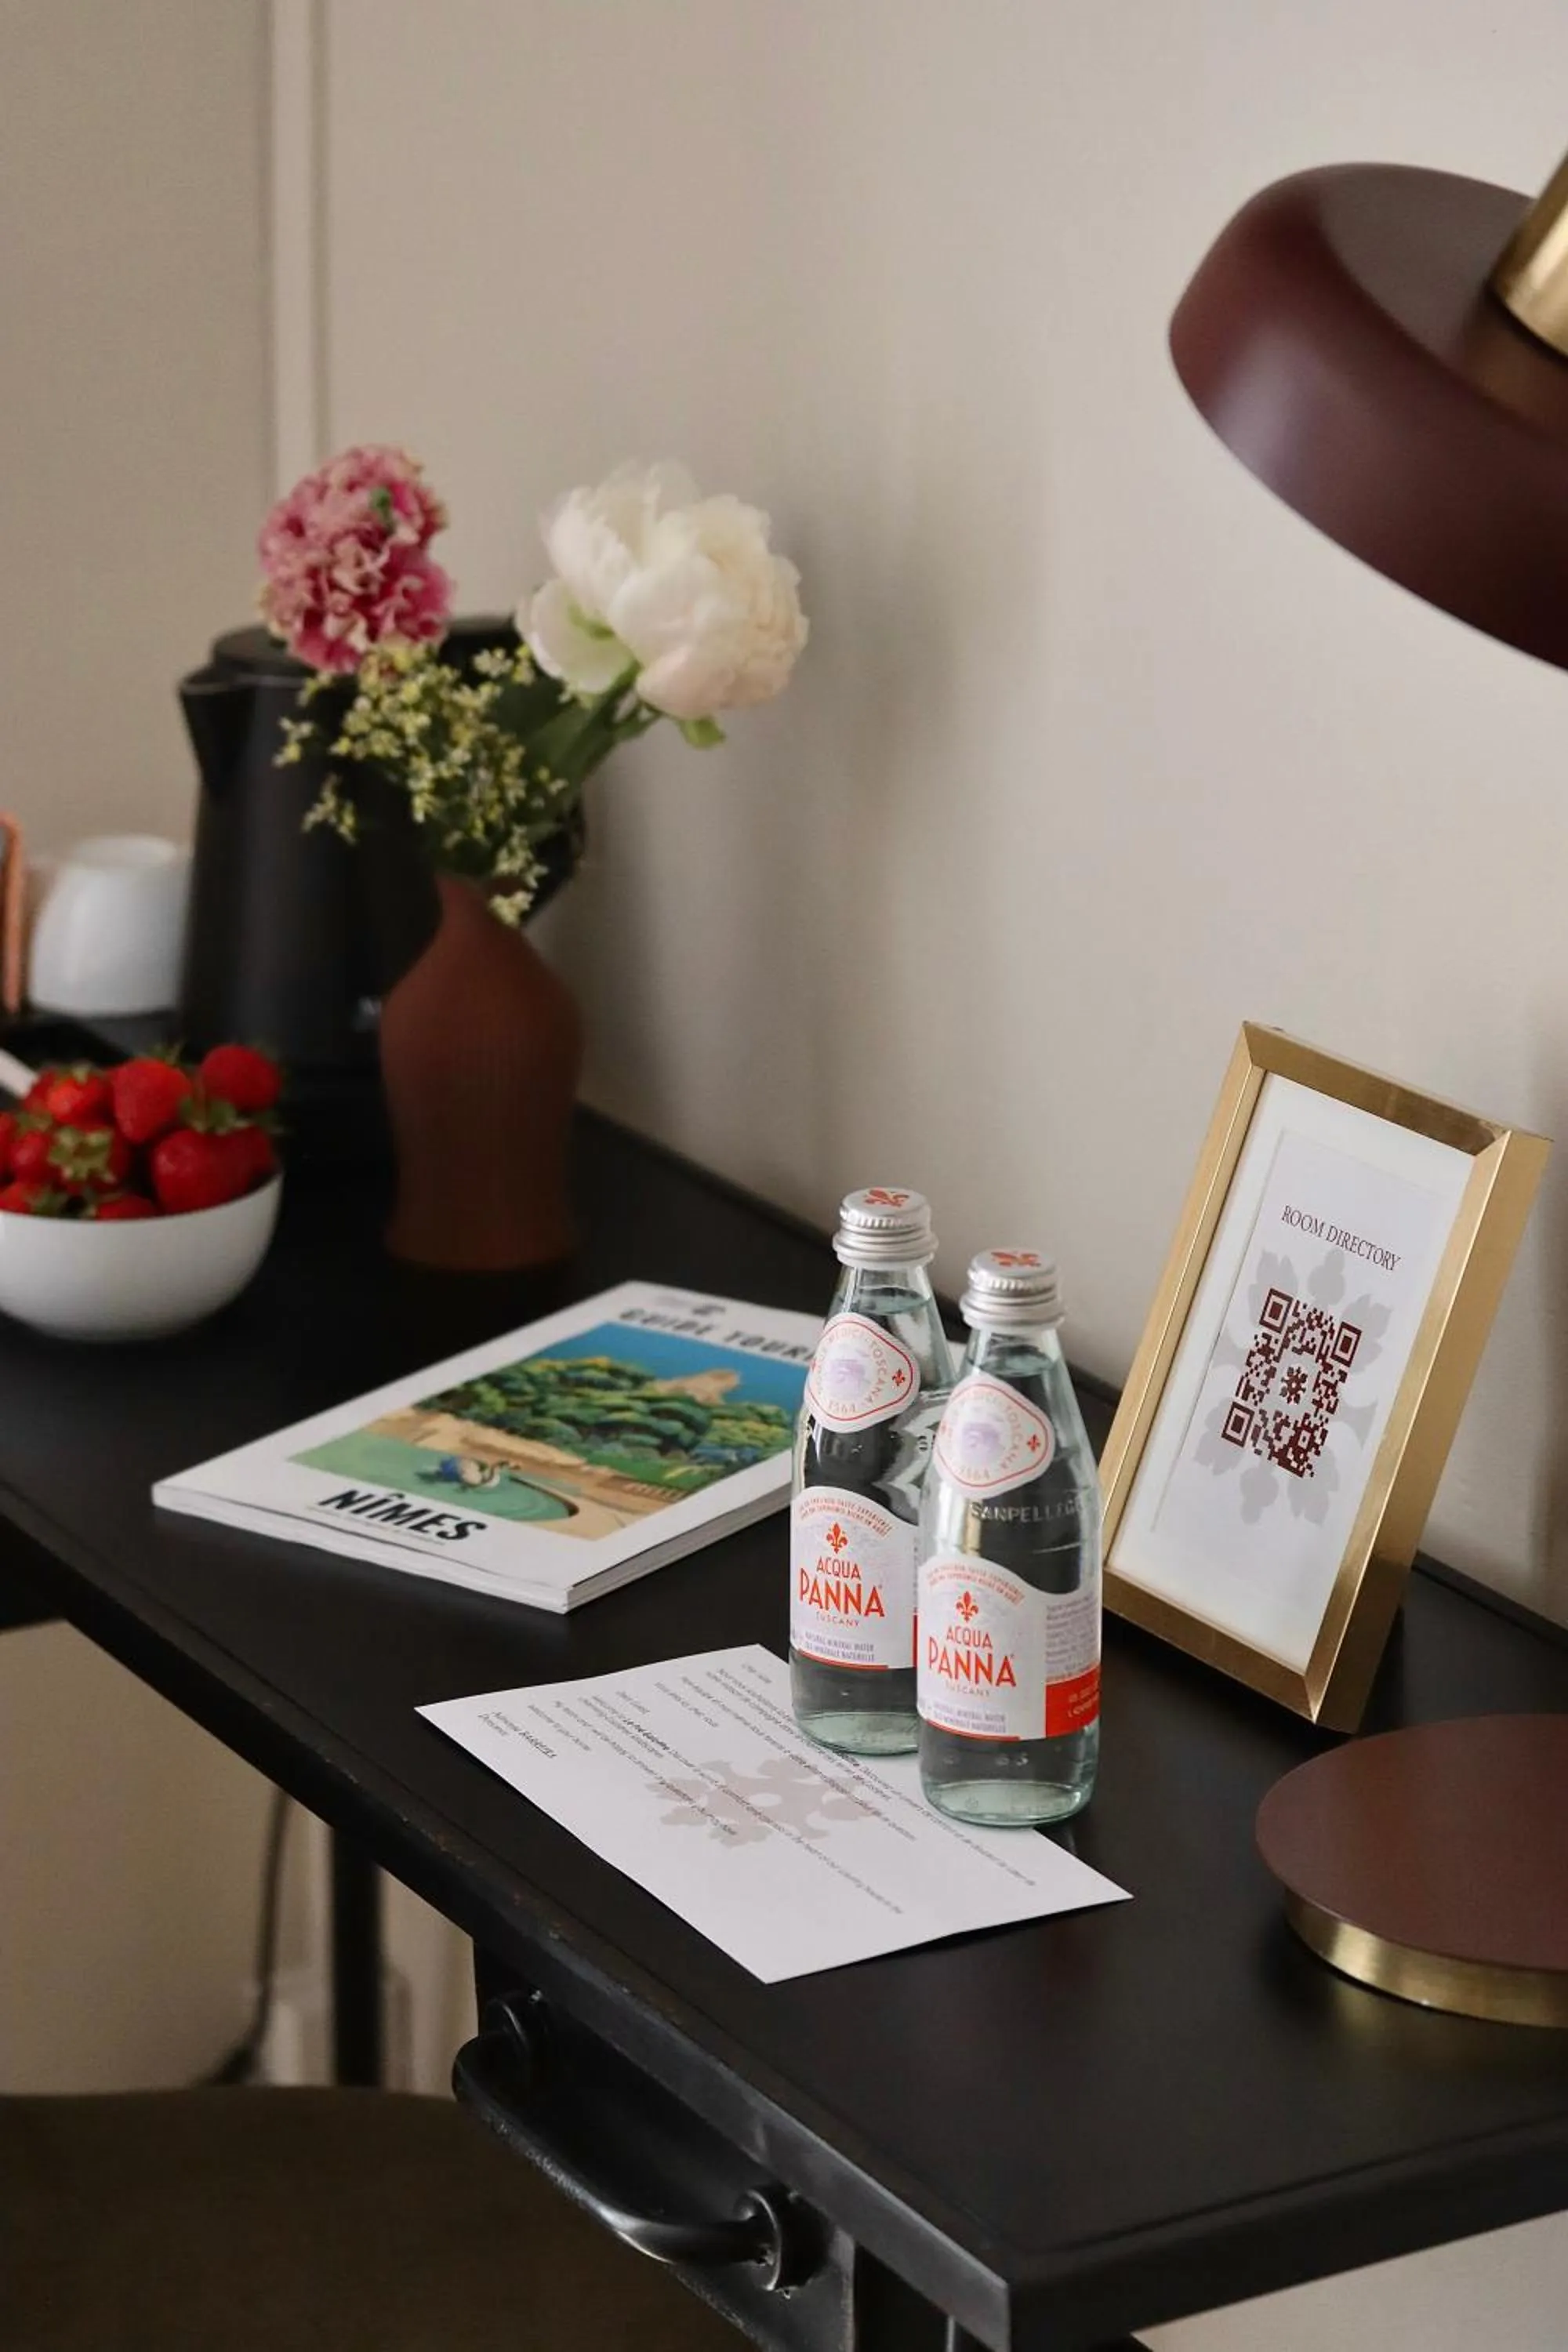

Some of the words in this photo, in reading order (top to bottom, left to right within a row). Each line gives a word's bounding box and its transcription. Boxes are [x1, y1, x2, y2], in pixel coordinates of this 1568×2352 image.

[1281, 1205, 1325, 1237] ROOM
[1326, 1225, 1401, 1271] DIRECTORY
[318, 1490, 488, 1540] NÎMES
[799, 1567, 885, 1617] PANNA
[816, 1556, 861, 1581] ACQUA
[929, 1636, 1016, 1687] PANNA
[946, 1626, 993, 1650] ACQUA
